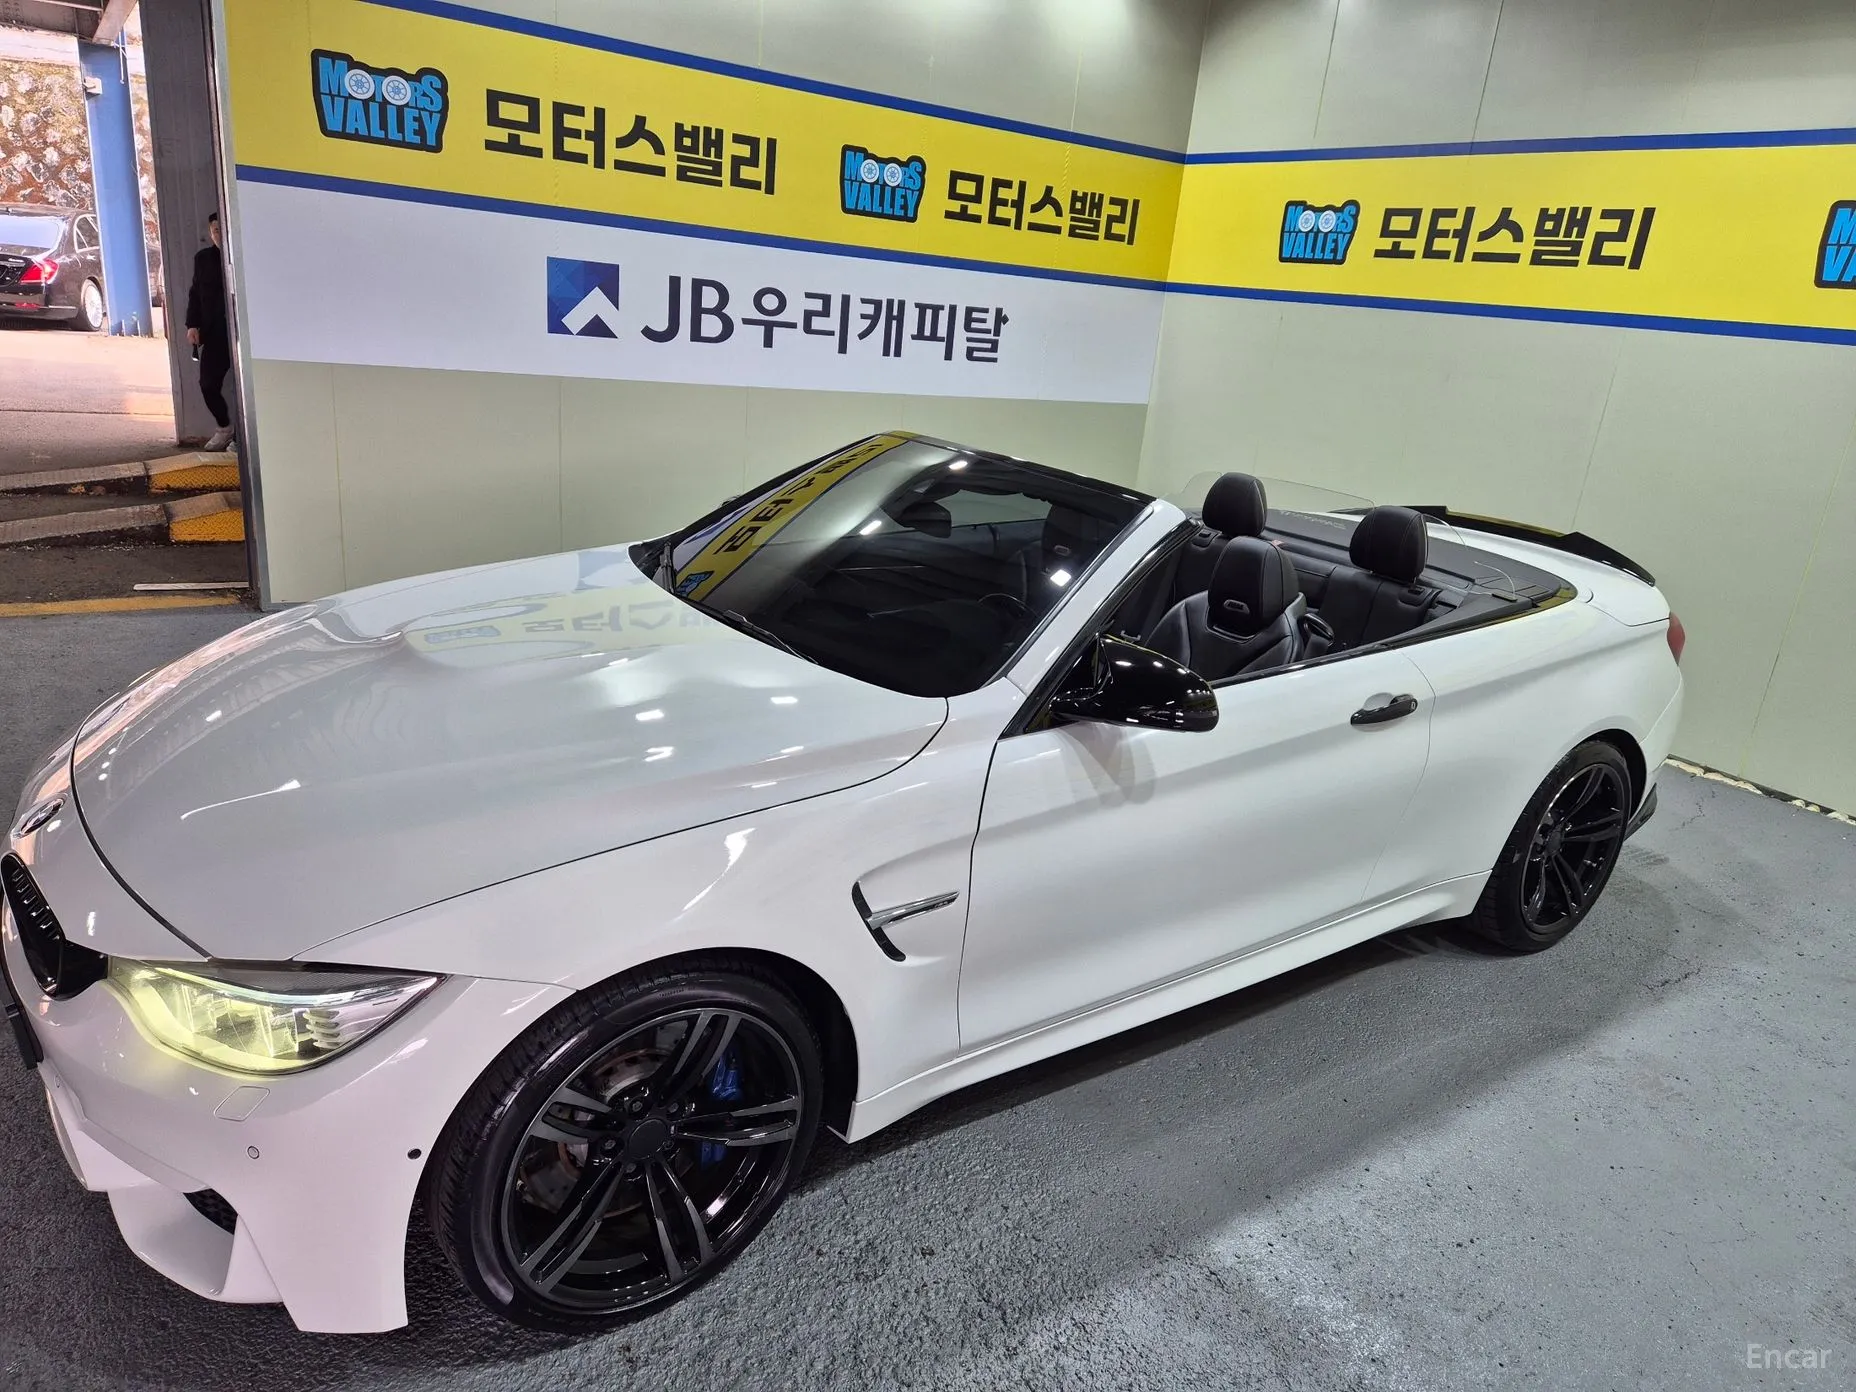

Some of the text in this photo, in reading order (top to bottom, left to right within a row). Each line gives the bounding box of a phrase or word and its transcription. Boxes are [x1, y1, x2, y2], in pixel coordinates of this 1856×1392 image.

[318, 56, 443, 112] MOTORS
[320, 94, 441, 146] VALLEY
[484, 88, 778, 196] 모터스밸리
[844, 150, 923, 191] MOTORS
[844, 180, 919, 218] VALLEY
[943, 169, 1141, 246] 모터스밸리
[1284, 204, 1357, 233] MOTORS
[1282, 232, 1351, 260] VALLEY
[1373, 206, 1657, 270] 모터스밸리
[640, 274, 1010, 364] JB우리캐피탈
